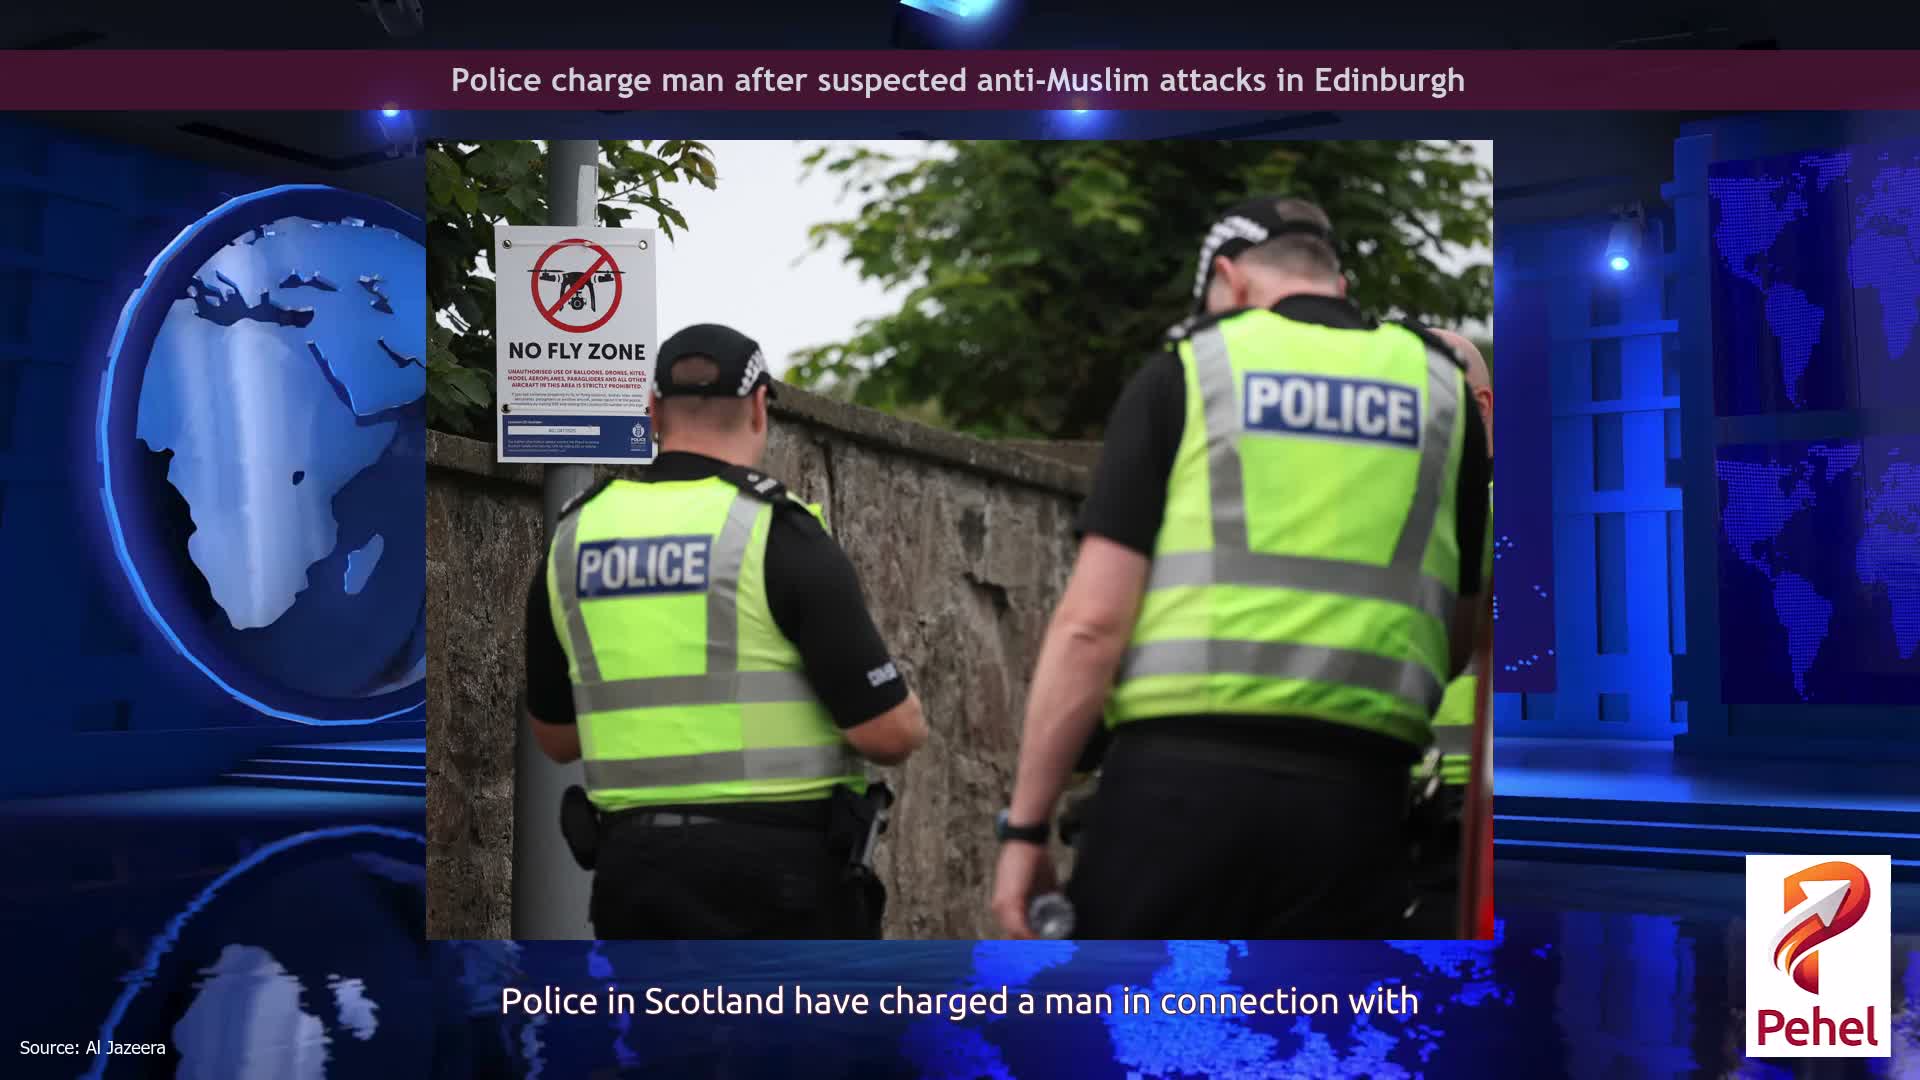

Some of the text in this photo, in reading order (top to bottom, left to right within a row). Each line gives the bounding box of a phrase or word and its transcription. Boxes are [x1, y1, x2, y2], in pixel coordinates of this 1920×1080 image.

[509, 341, 646, 361] NO FLY ZONE
[1247, 375, 1414, 439] POLICE
[580, 542, 706, 590] POLICE
